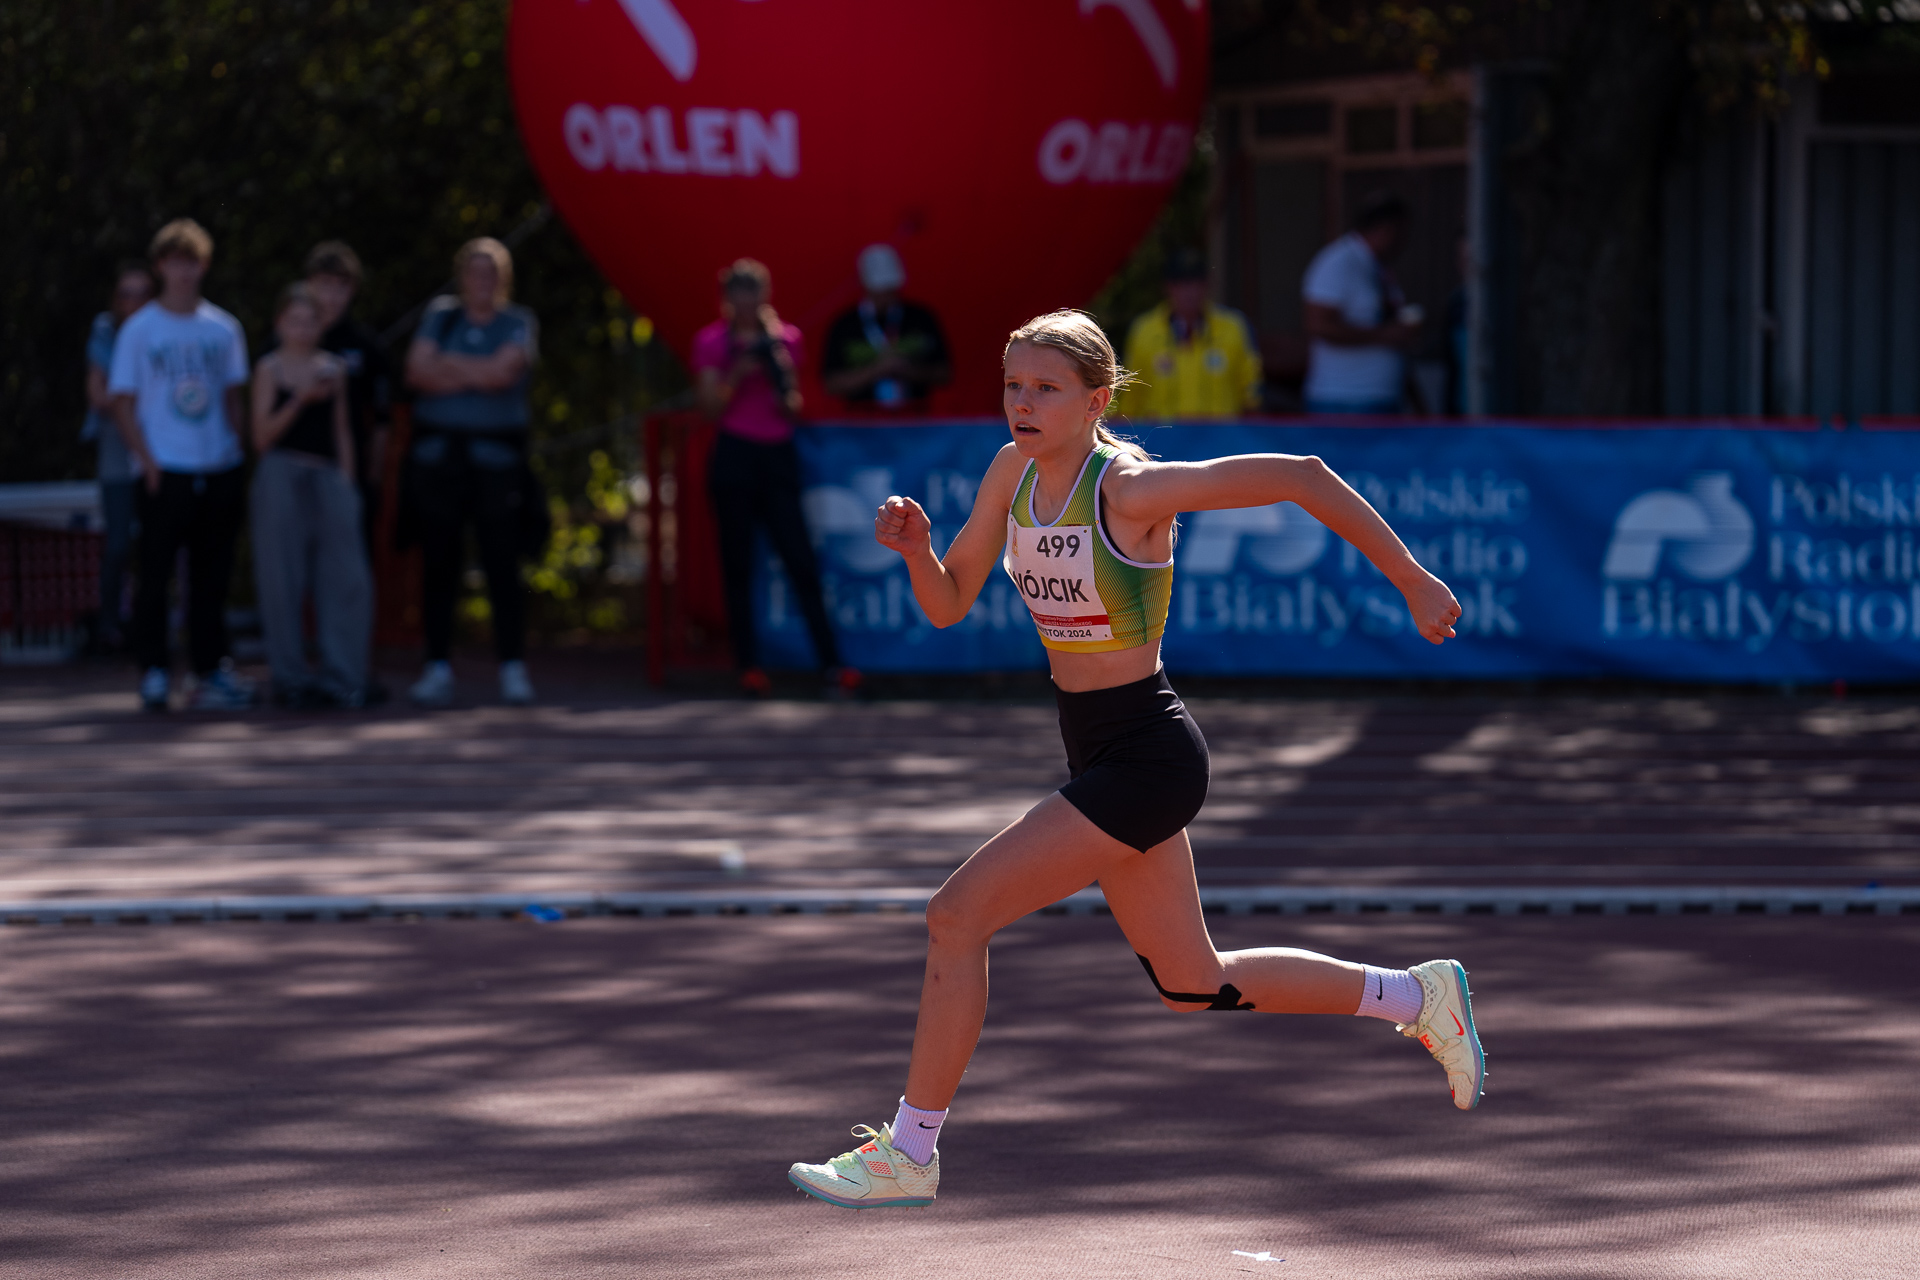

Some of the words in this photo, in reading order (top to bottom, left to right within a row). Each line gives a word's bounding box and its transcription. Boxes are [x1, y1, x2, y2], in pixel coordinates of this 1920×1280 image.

[563, 102, 800, 178] ORLEN
[1036, 534, 1081, 558] 499
[1769, 530, 1920, 581] Radi
[1067, 629, 1093, 638] 2024
